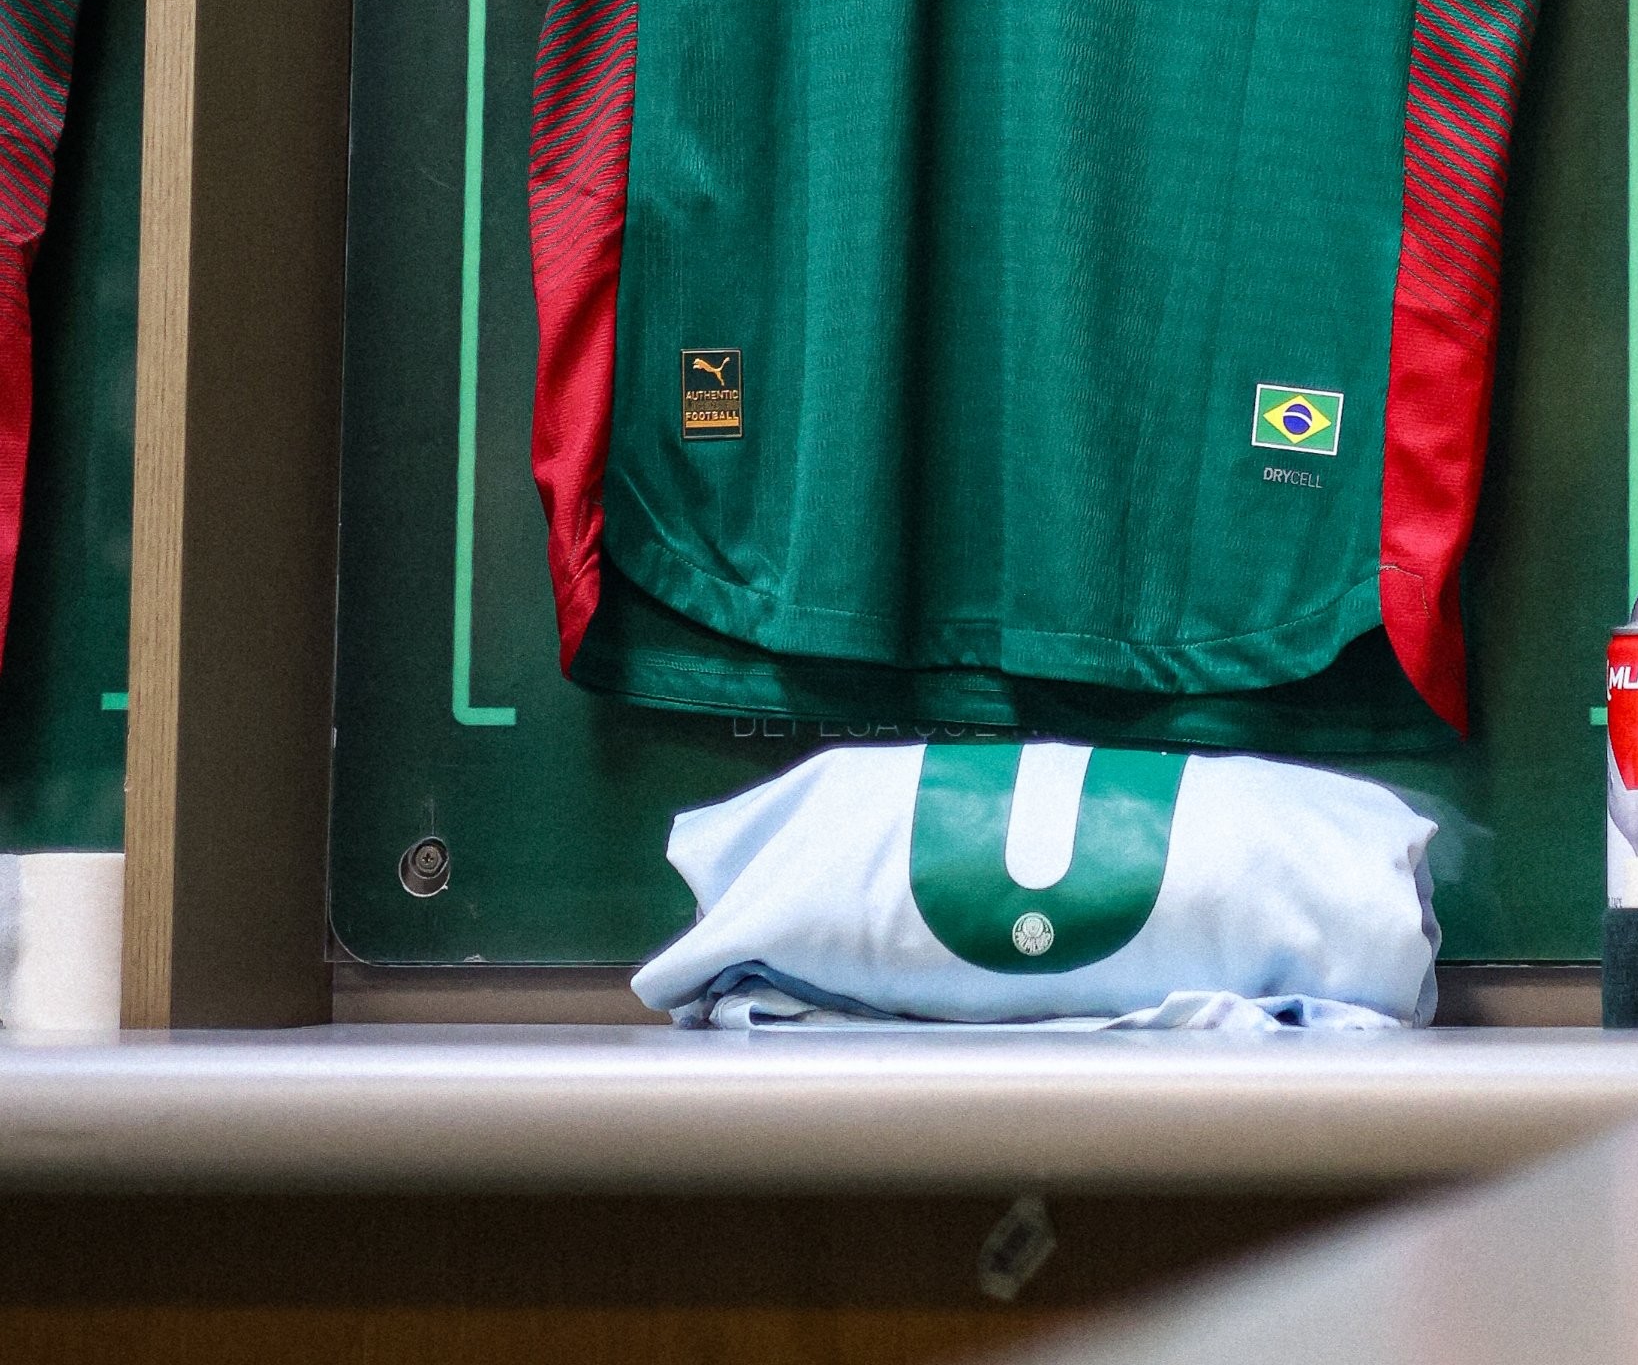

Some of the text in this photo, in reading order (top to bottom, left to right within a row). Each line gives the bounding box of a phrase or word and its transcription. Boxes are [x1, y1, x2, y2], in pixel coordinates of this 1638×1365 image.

[685, 389, 739, 401] AUTHENTIC
[685, 410, 739, 421] FOOTBALL
[1263, 467, 1324, 489] DRYCELL
